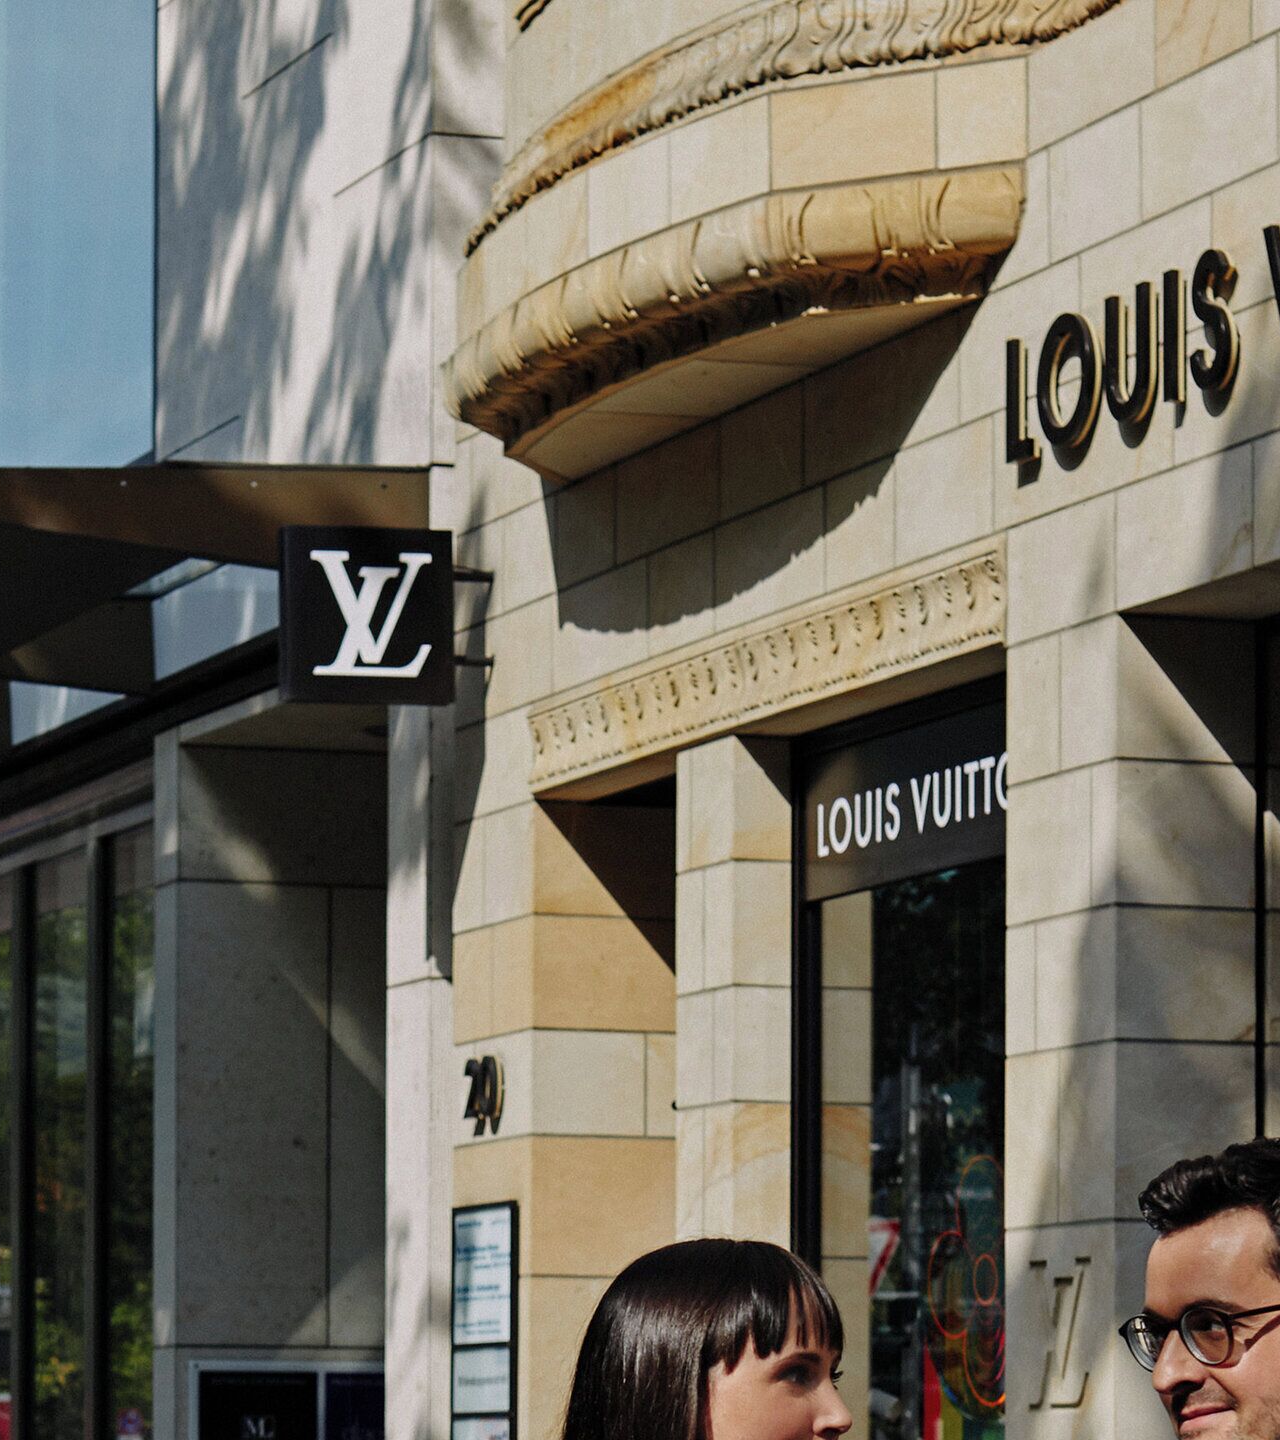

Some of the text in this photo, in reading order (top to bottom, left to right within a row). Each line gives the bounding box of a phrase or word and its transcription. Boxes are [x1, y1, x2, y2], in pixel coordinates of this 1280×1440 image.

[1006, 248, 1241, 465] LOUIS
[817, 782, 901, 858] LOUIS
[463, 1055, 503, 1120] 20
